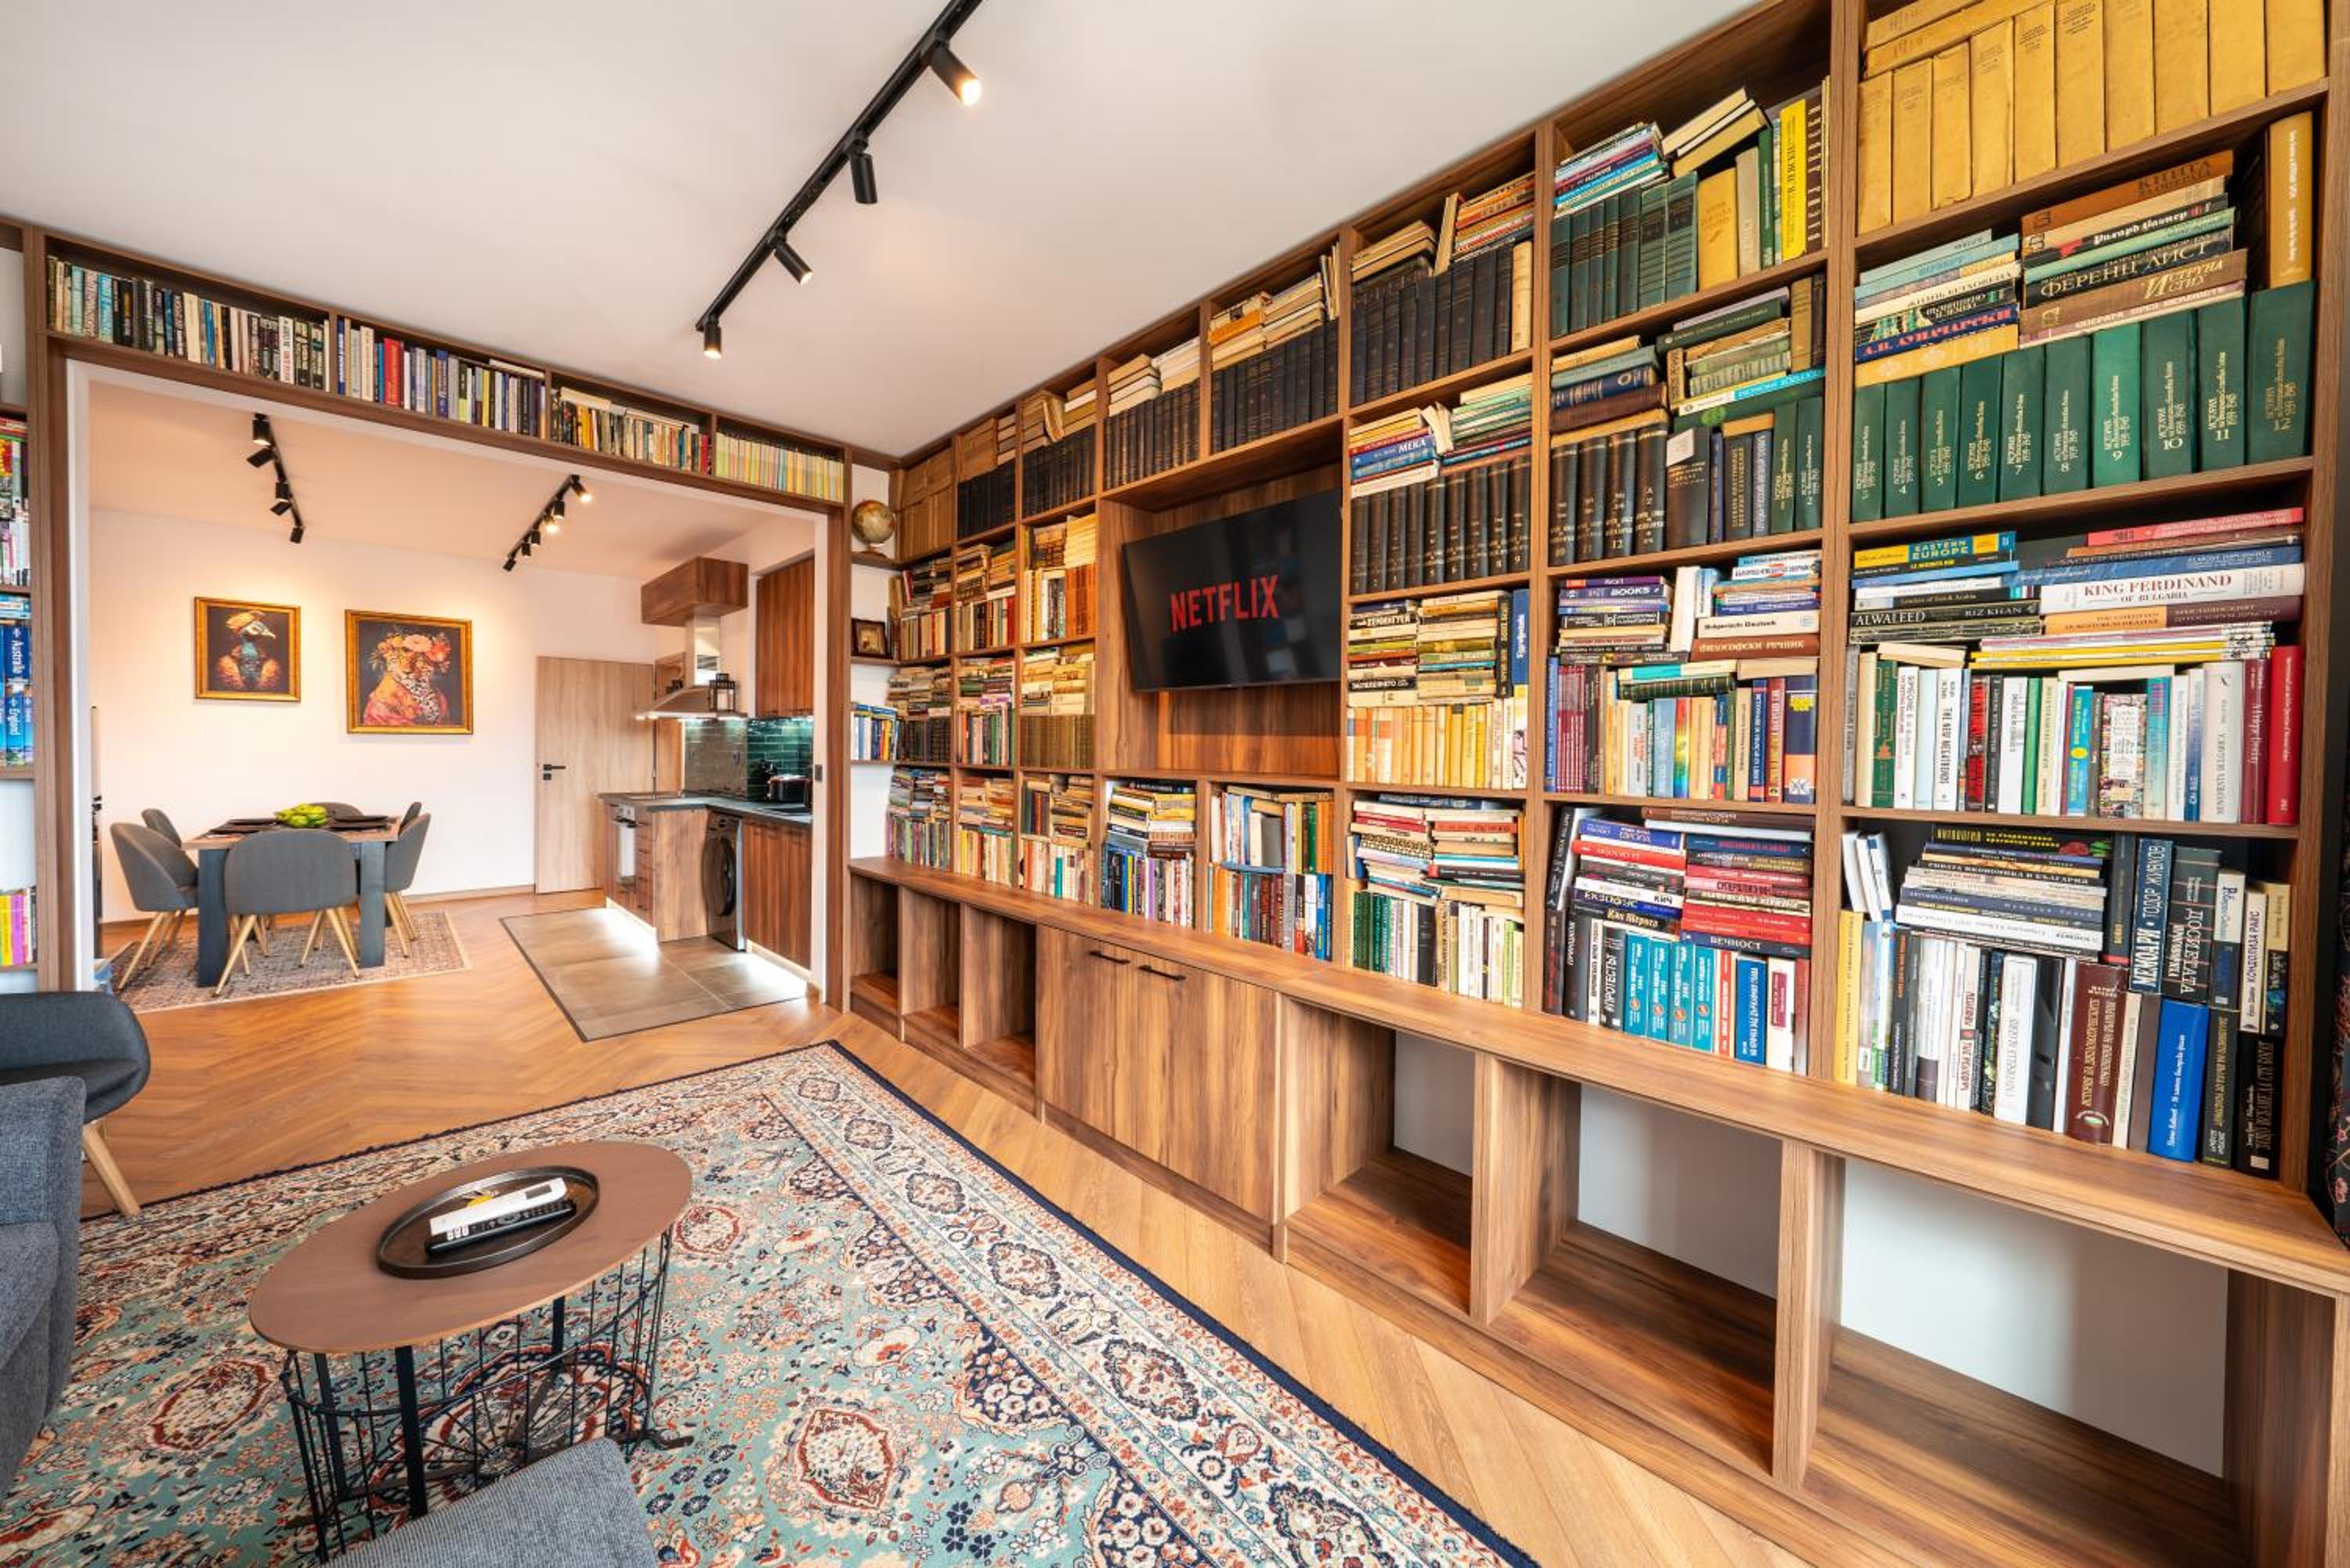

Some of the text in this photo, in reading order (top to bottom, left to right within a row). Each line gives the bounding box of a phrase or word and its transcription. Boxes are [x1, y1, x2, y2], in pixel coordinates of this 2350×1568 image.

[2041, 243, 2208, 297] ФЕРЕНЦ ЛИСТ
[2216, 429, 2230, 441] 11
[2164, 439, 2183, 450] 10
[1899, 484, 1906, 495] 4
[1915, 540, 1967, 552] EASTERN
[1912, 547, 1969, 560] EUROPE
[1611, 587, 1650, 596] BOOKS
[2084, 575, 2232, 598] KING FERDINAND
[1170, 575, 1279, 633] NETFLIX
[2138, 592, 2188, 602] BULGARIA
[1856, 606, 2022, 627] ALWALEED RIZ KHAN
[1940, 708, 1953, 784] THE NEW MEGATRENDS
[1654, 895, 1673, 905] КИЧ
[2132, 845, 2165, 987] МЕМОАРИ ТОДОР ЖИВКОВ
[1710, 936, 1762, 950] ВЕЧНОСТ
[2180, 909, 2204, 993] ДОСИЕТАТА
[2247, 934, 2258, 984] КОНДОЛИЗА
